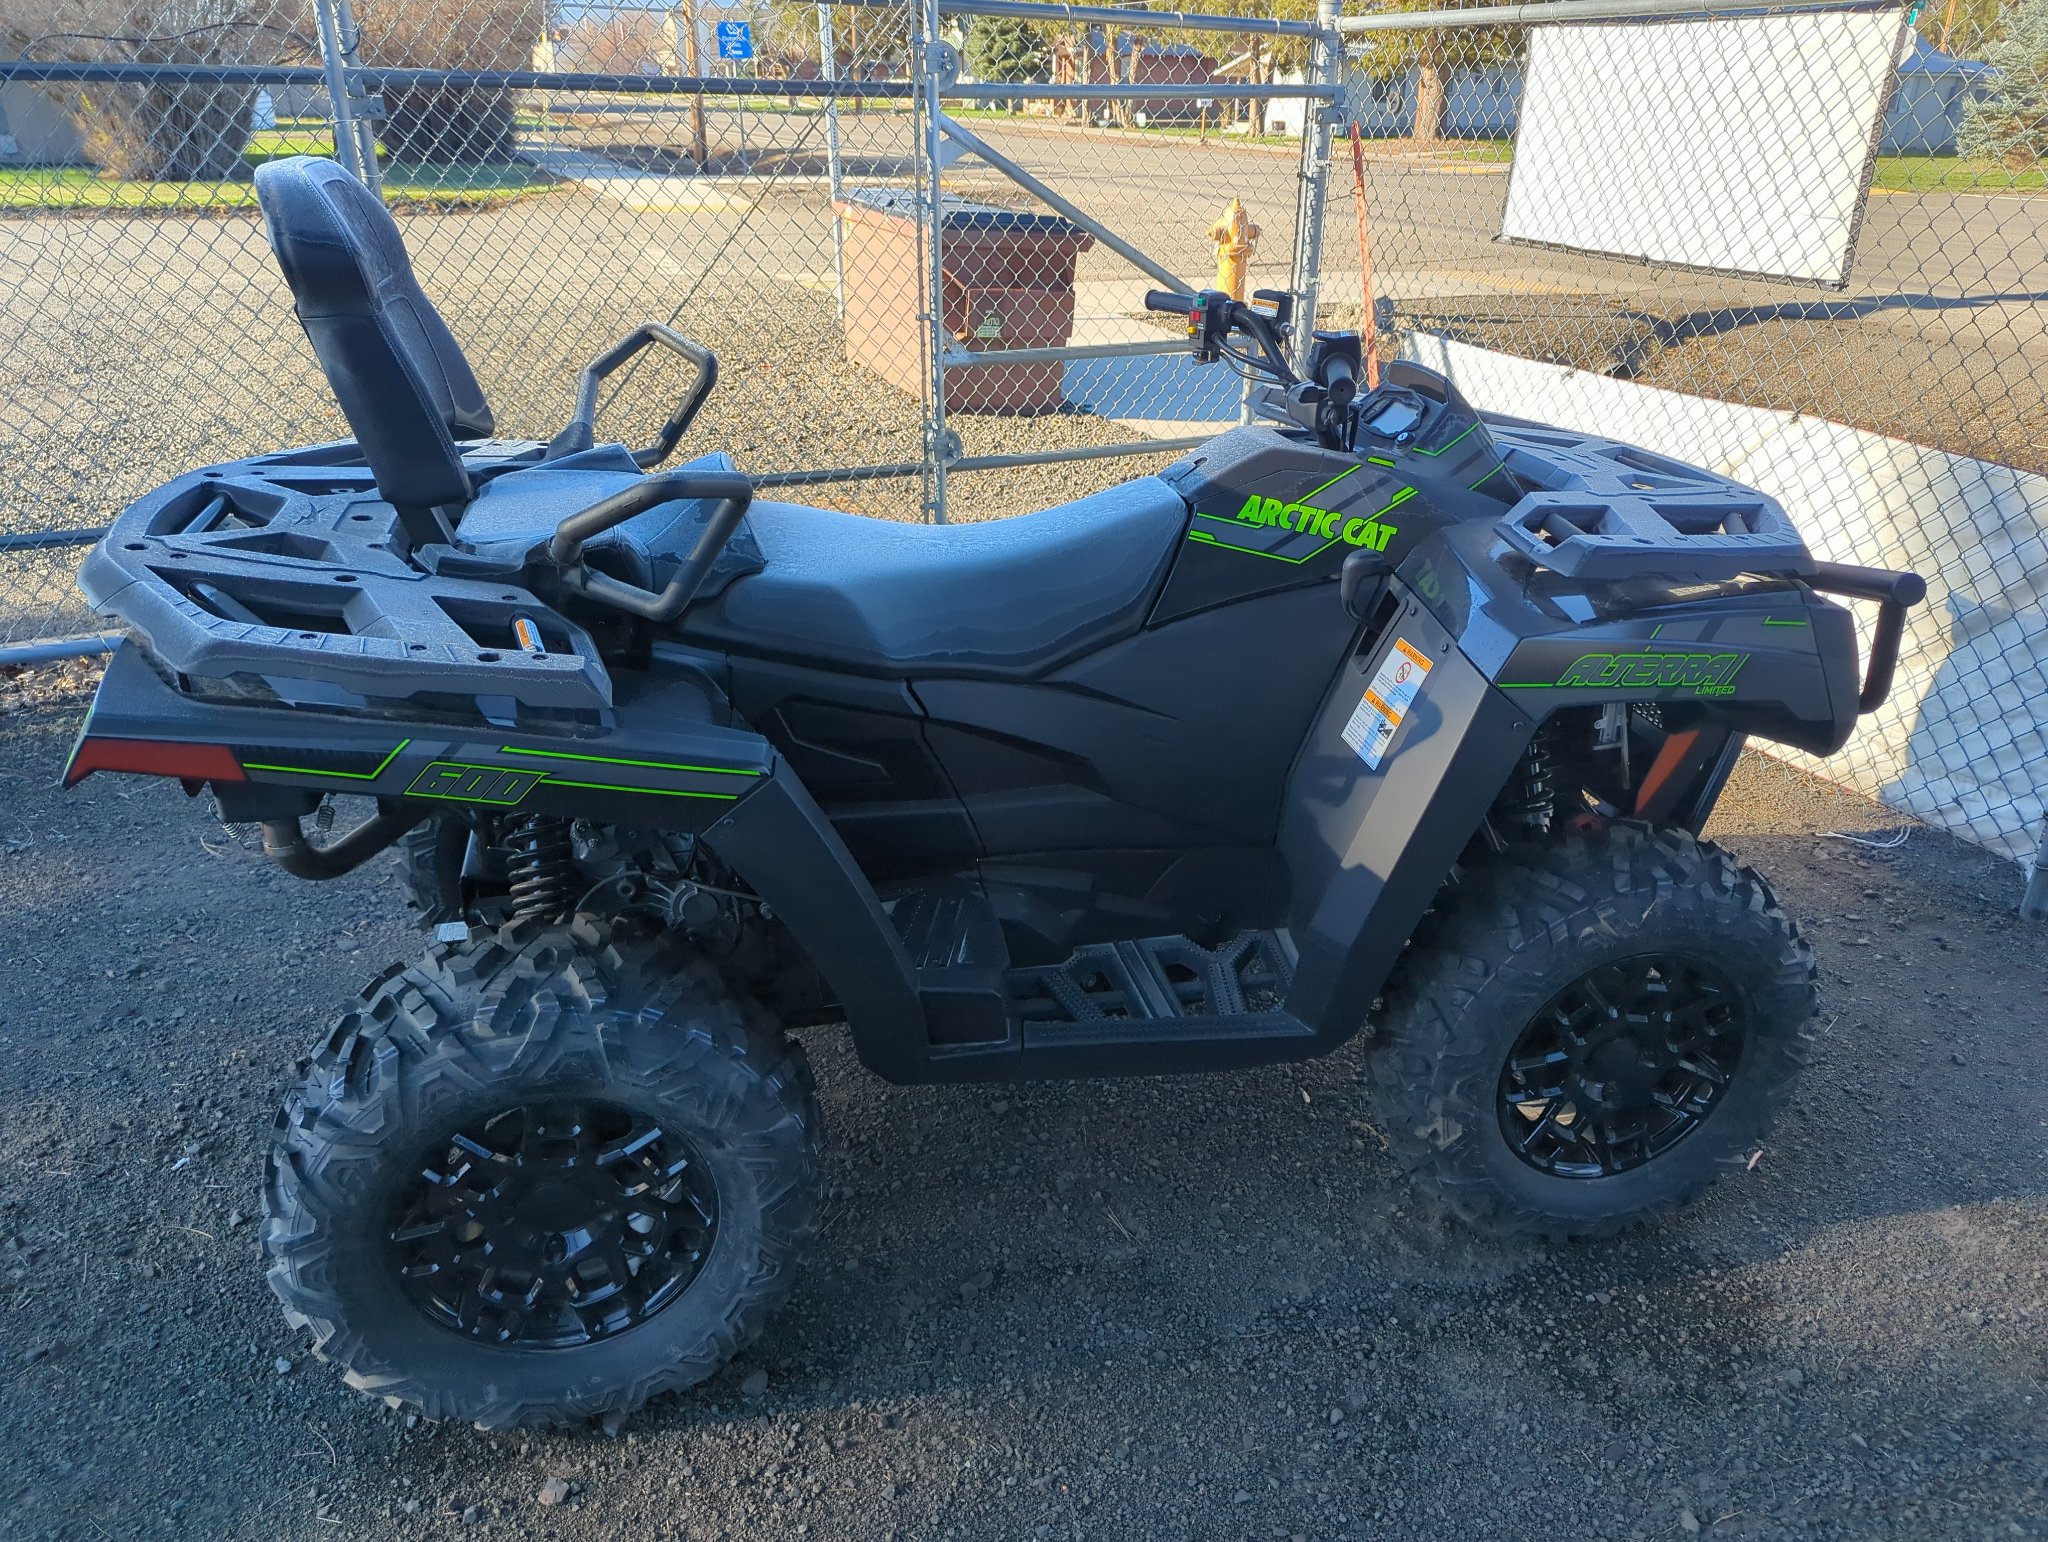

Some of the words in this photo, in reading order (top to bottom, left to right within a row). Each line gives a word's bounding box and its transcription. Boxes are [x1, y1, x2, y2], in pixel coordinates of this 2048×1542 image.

[1236, 494, 1342, 539] ARCTIC
[1342, 517, 1398, 552] CAT
[1406, 647, 1425, 666] WARNING
[1555, 653, 1742, 688] ALTERRA
[1693, 685, 1737, 697] LIMITED
[403, 761, 551, 805] 600
